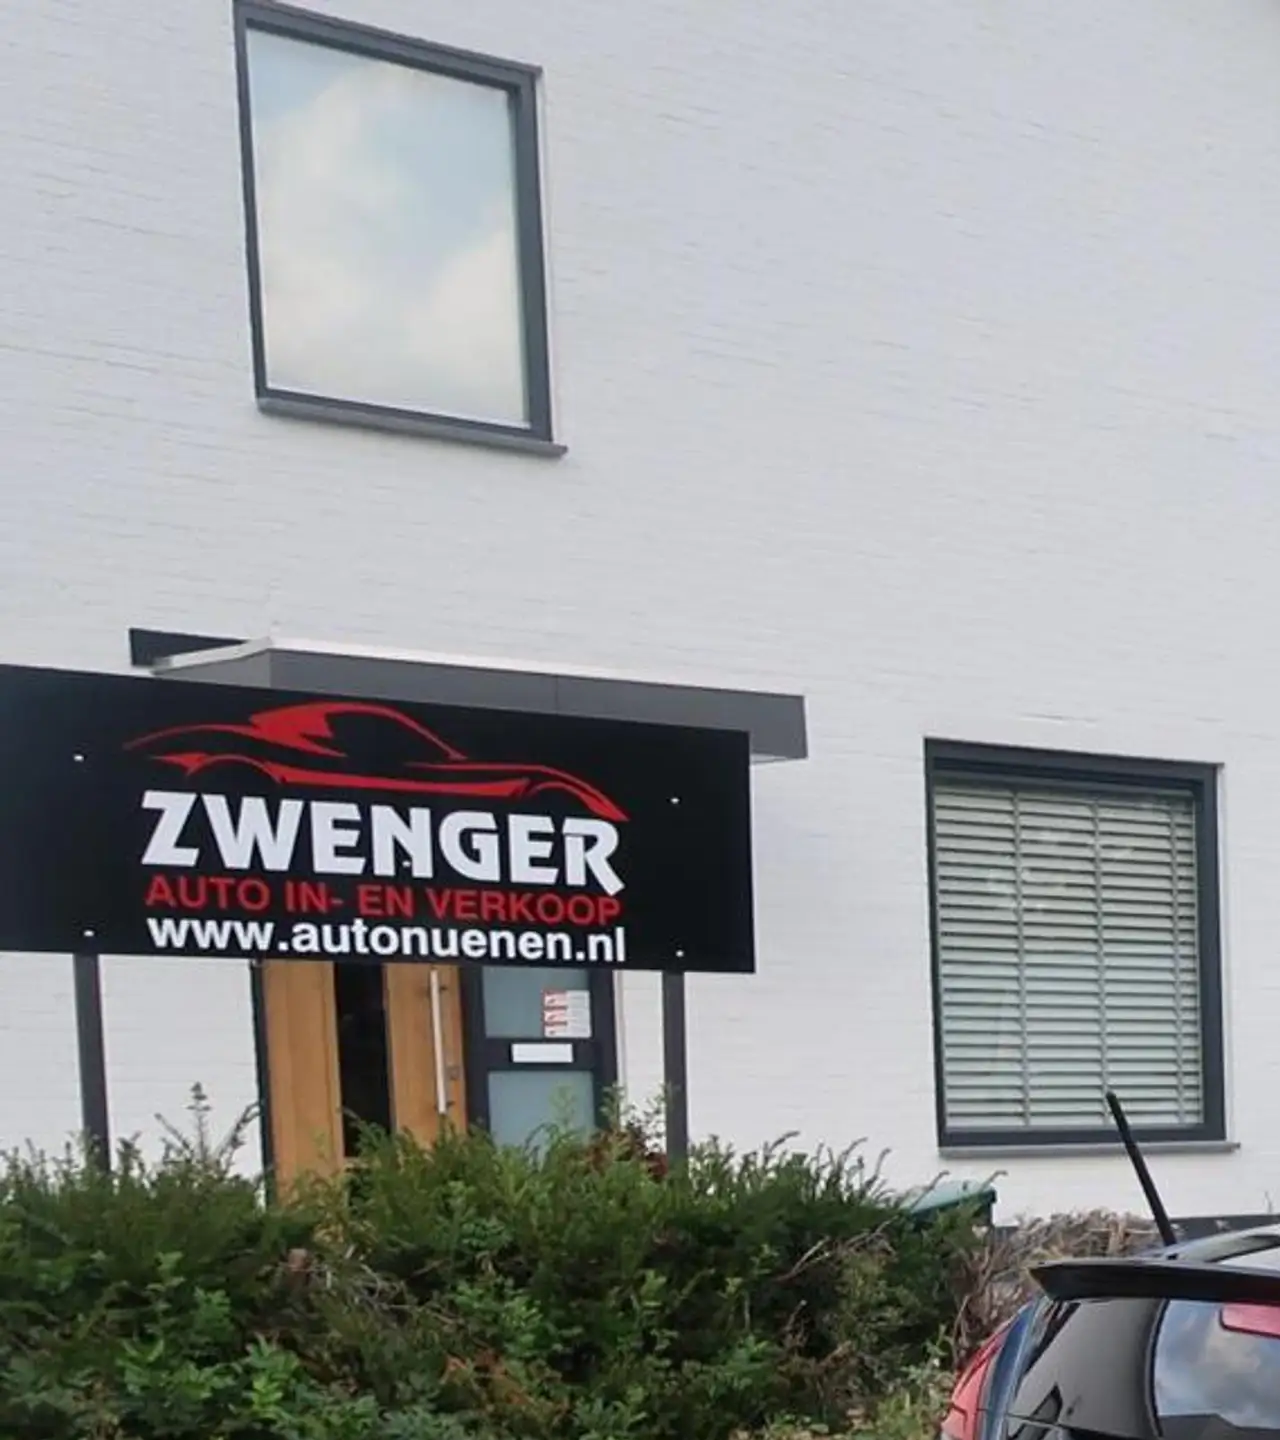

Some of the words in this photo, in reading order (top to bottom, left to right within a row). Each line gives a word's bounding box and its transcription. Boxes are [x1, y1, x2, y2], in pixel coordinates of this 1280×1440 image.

[141, 790, 626, 896] ZWENGER
[145, 873, 271, 912] AUTO
[285, 879, 344, 914] IN-
[357, 883, 414, 918] EN
[425, 888, 622, 926] VERKOOP
[146, 917, 626, 963] www.autonuenen.nl
